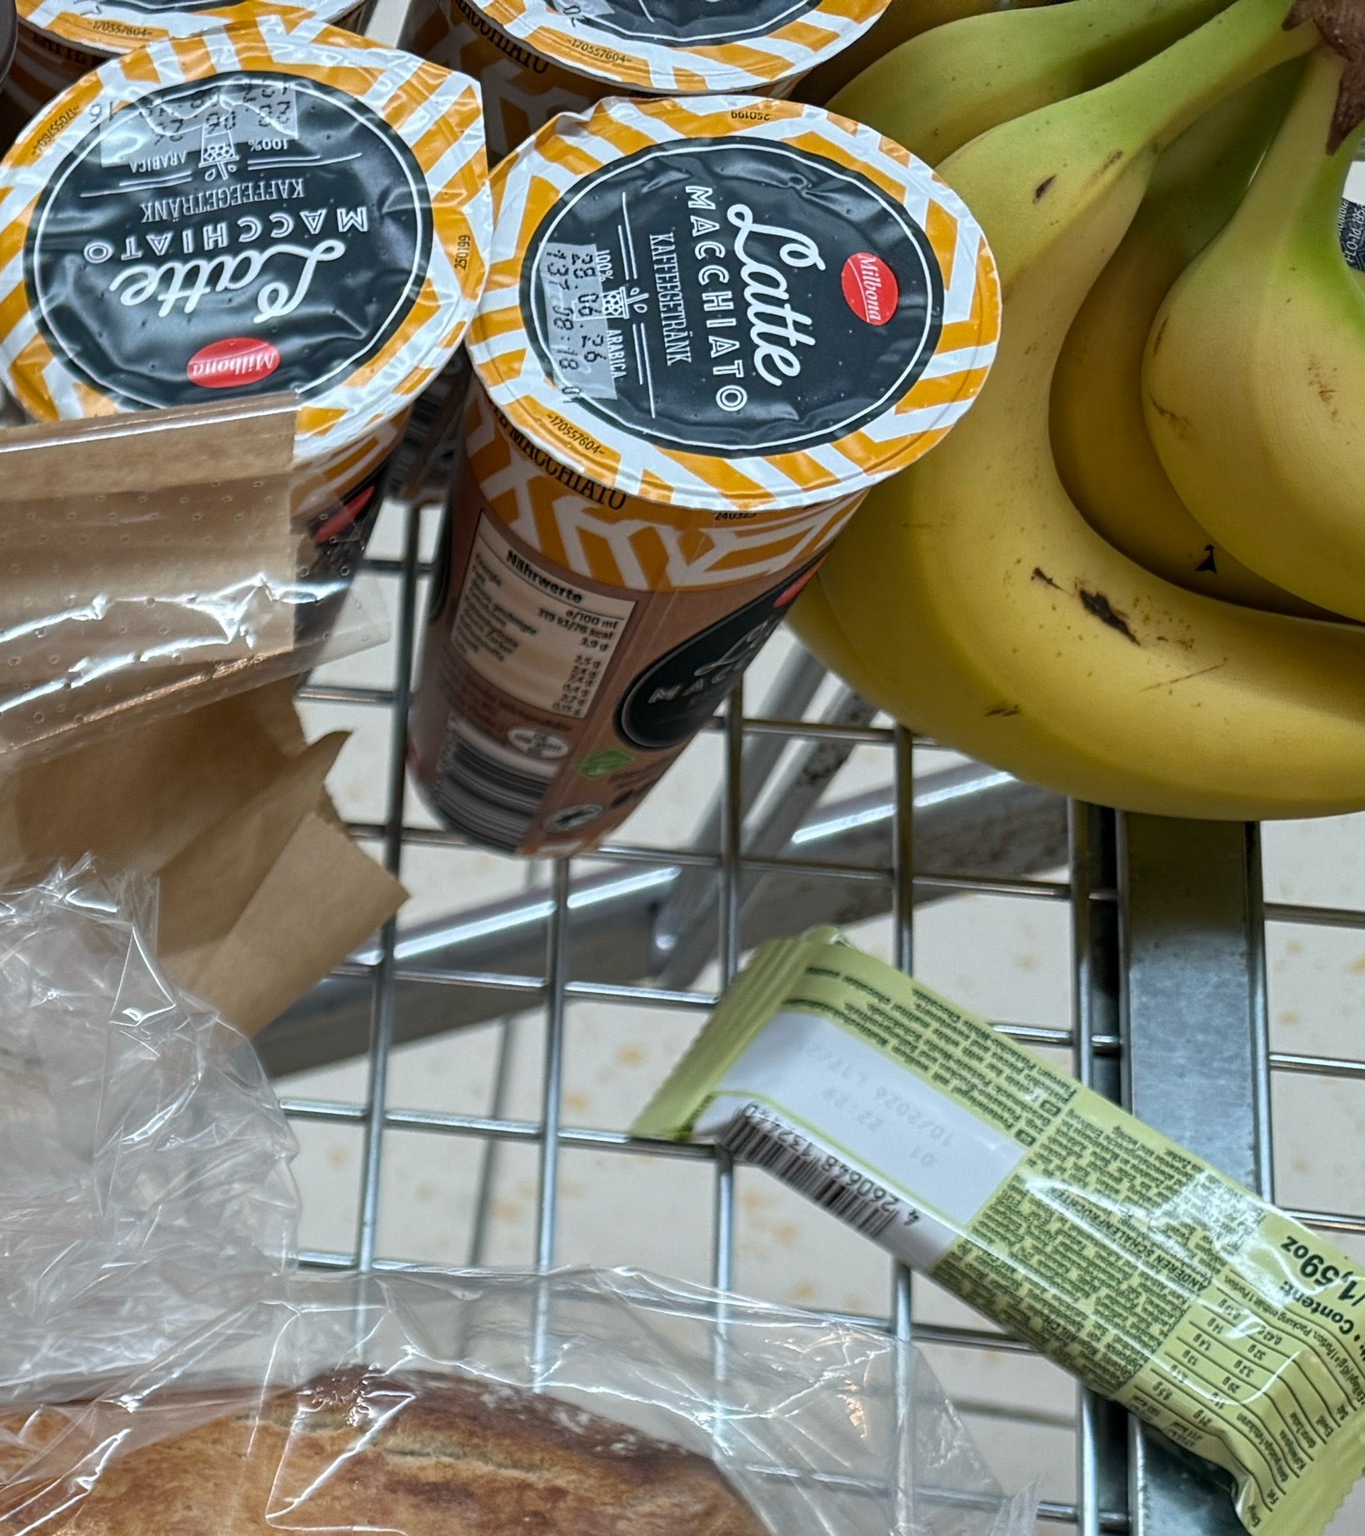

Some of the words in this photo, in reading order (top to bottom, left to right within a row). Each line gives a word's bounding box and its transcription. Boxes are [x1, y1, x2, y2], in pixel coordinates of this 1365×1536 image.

[129, 148, 187, 173] ARABICA
[248, 137, 289, 152] 100%
[140, 177, 306, 224] KAFFEEGETRÄNK
[84, 206, 370, 265] MACCHIATO
[110, 239, 346, 325] Latte
[649, 232, 692, 366] KAFFEEGETRÄNK
[685, 185, 749, 412] MACCHIATO
[726, 203, 827, 388] Latte
[858, 253, 882, 323] Milbona
[595, 249, 615, 283] 100%
[605, 329, 628, 381] ARABICA
[191, 345, 276, 379] Milbona
[505, 549, 584, 605] Nährwerte
